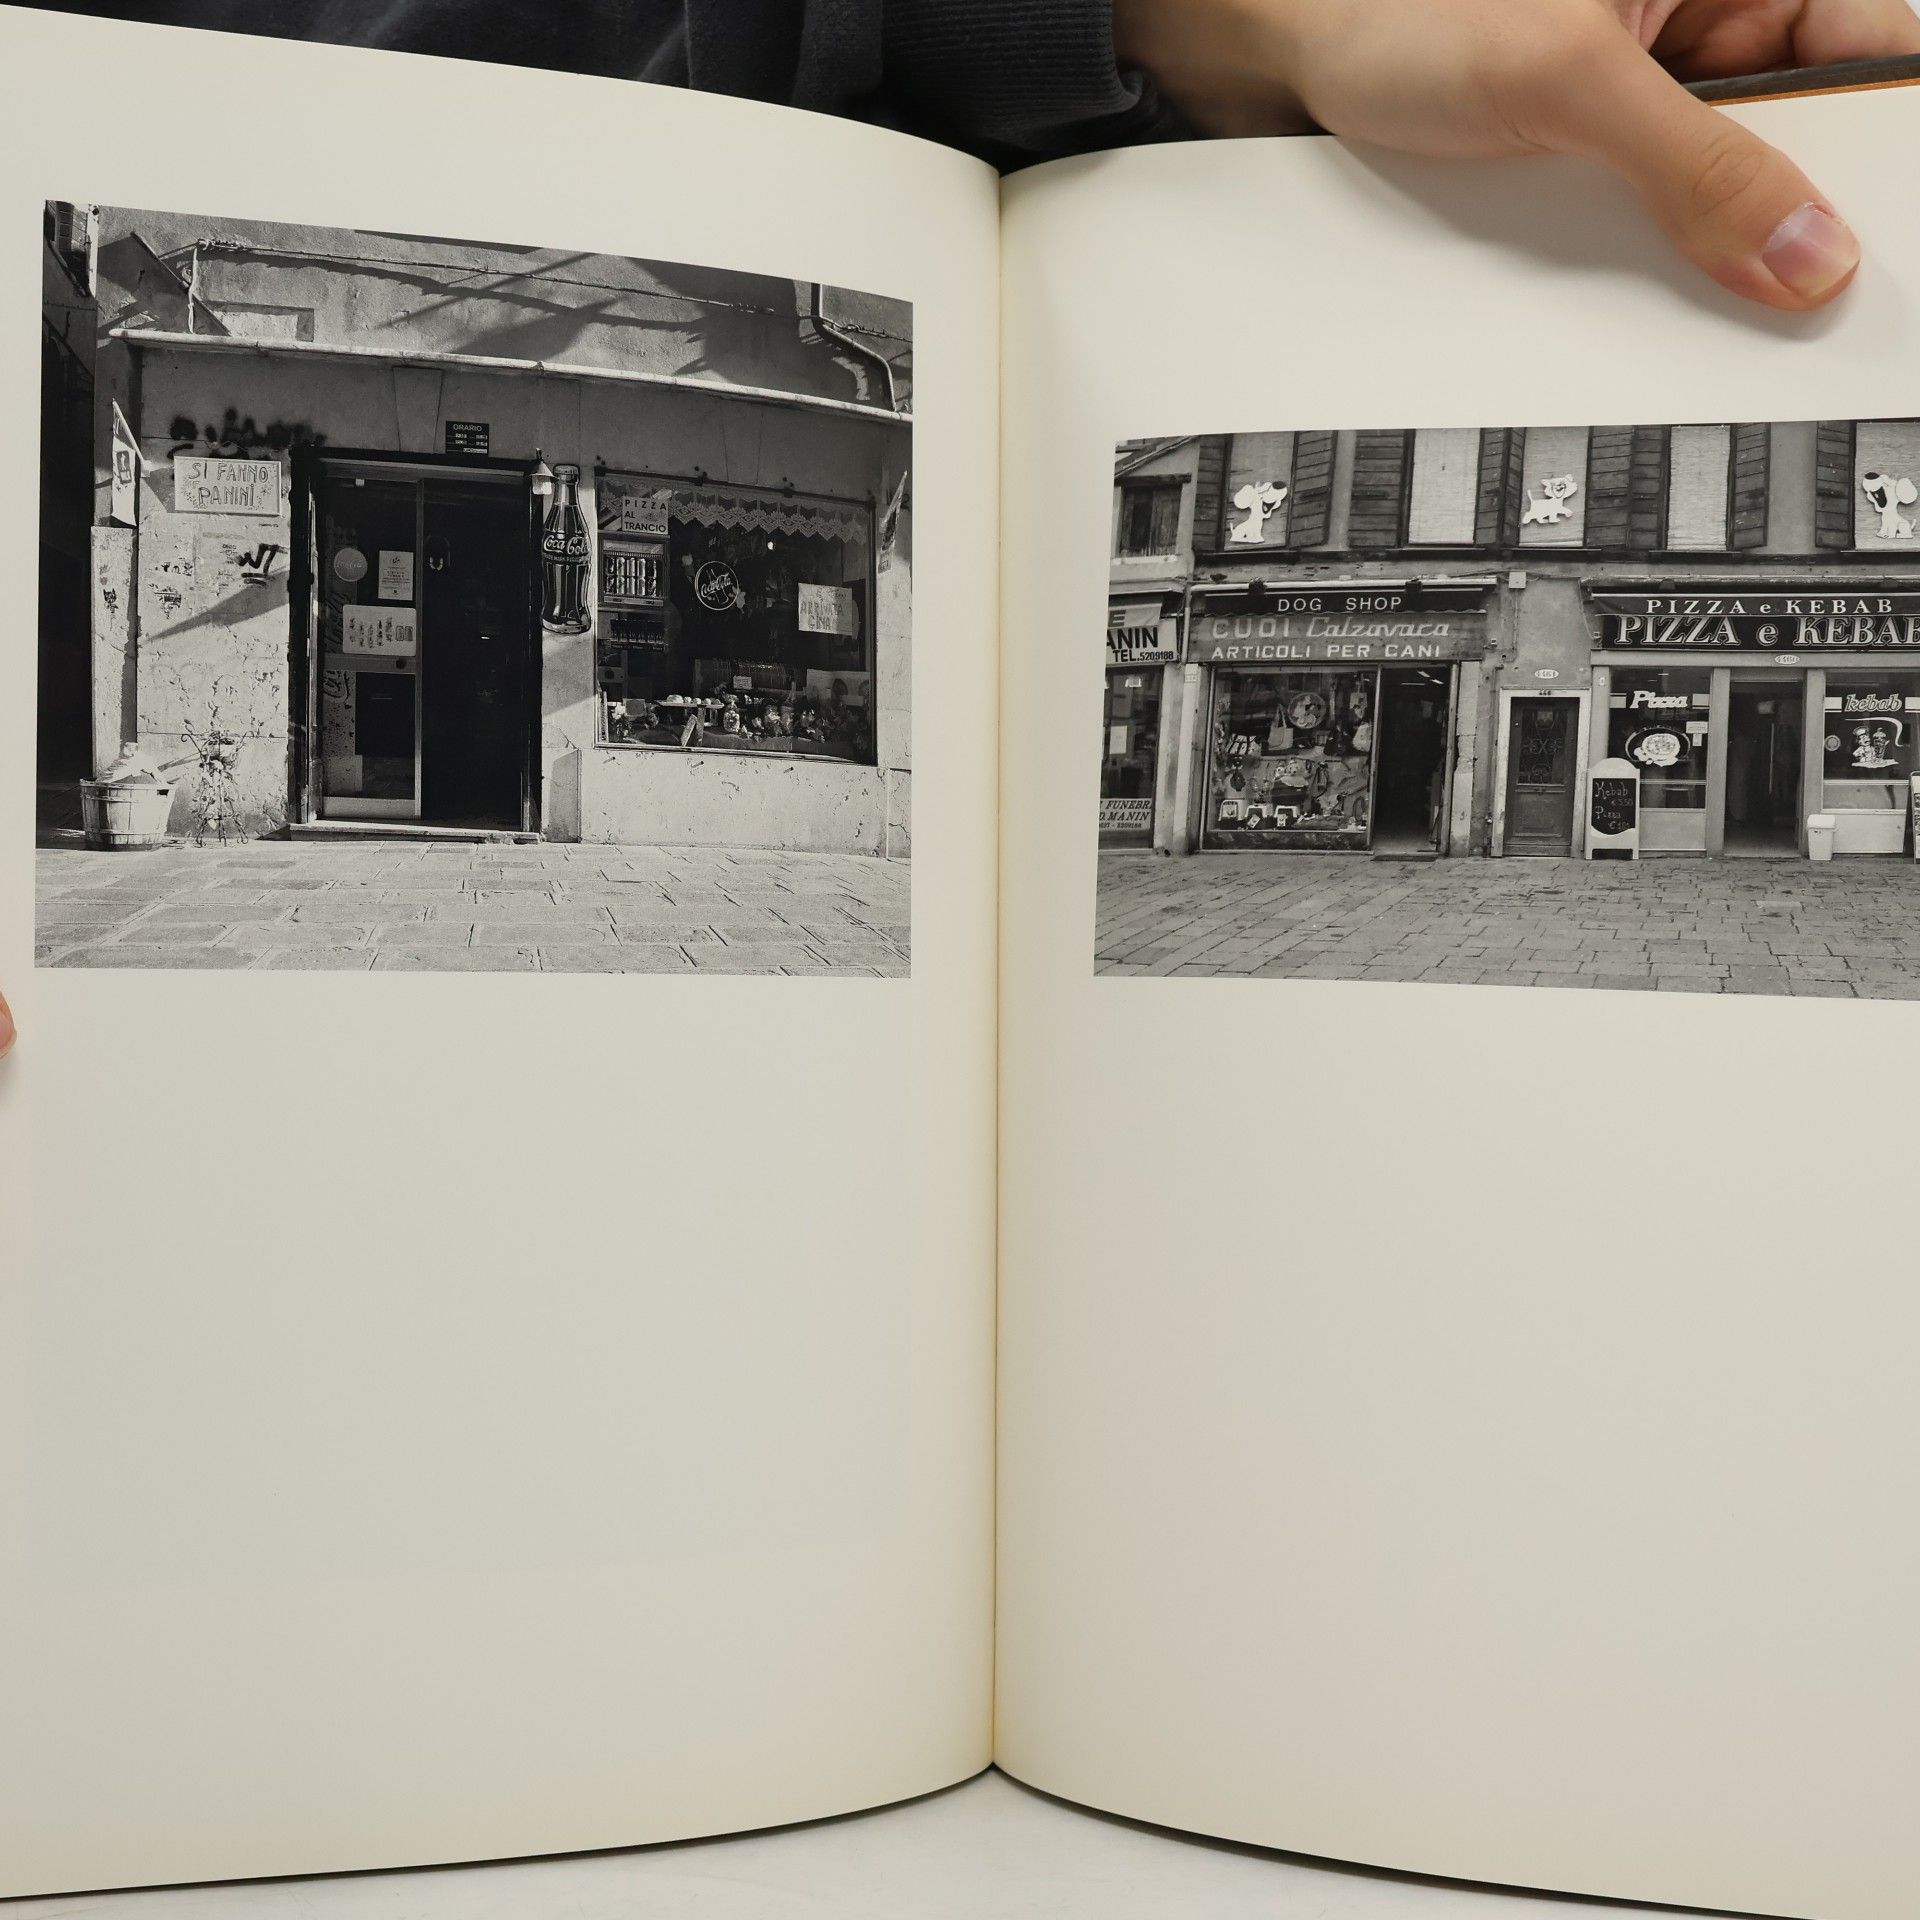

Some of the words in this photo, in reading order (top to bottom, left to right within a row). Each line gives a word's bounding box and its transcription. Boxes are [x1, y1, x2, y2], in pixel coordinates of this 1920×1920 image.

[453, 423, 482, 431] ORARIO
[188, 460, 208, 480] SI
[216, 462, 269, 484] FANNO
[198, 484, 255, 507] PANINI
[625, 499, 667, 511] PIZZA
[624, 510, 636, 519] AL
[624, 521, 667, 533] TRANCIO
[1278, 598, 1322, 612] DOG
[1345, 596, 1402, 611] SHOP
[1646, 599, 1747, 614] PIZZA
[1759, 603, 1772, 614] e
[1786, 598, 1892, 614] KEBAB
[1212, 617, 1290, 639] CUOI
[1615, 615, 1741, 645] PIZZA
[1756, 623, 1779, 646] e
[1794, 615, 1920, 646] KEBAB
[1211, 644, 1311, 660] ARTICOLI
[1327, 644, 1370, 658] PER
[1385, 644, 1440, 658] CANI
[1629, 690, 1689, 709] Pizza
[1844, 693, 1903, 713] kebab
[1594, 781, 1628, 800] Kebab
[1105, 800, 1152, 809] FUNEBR
